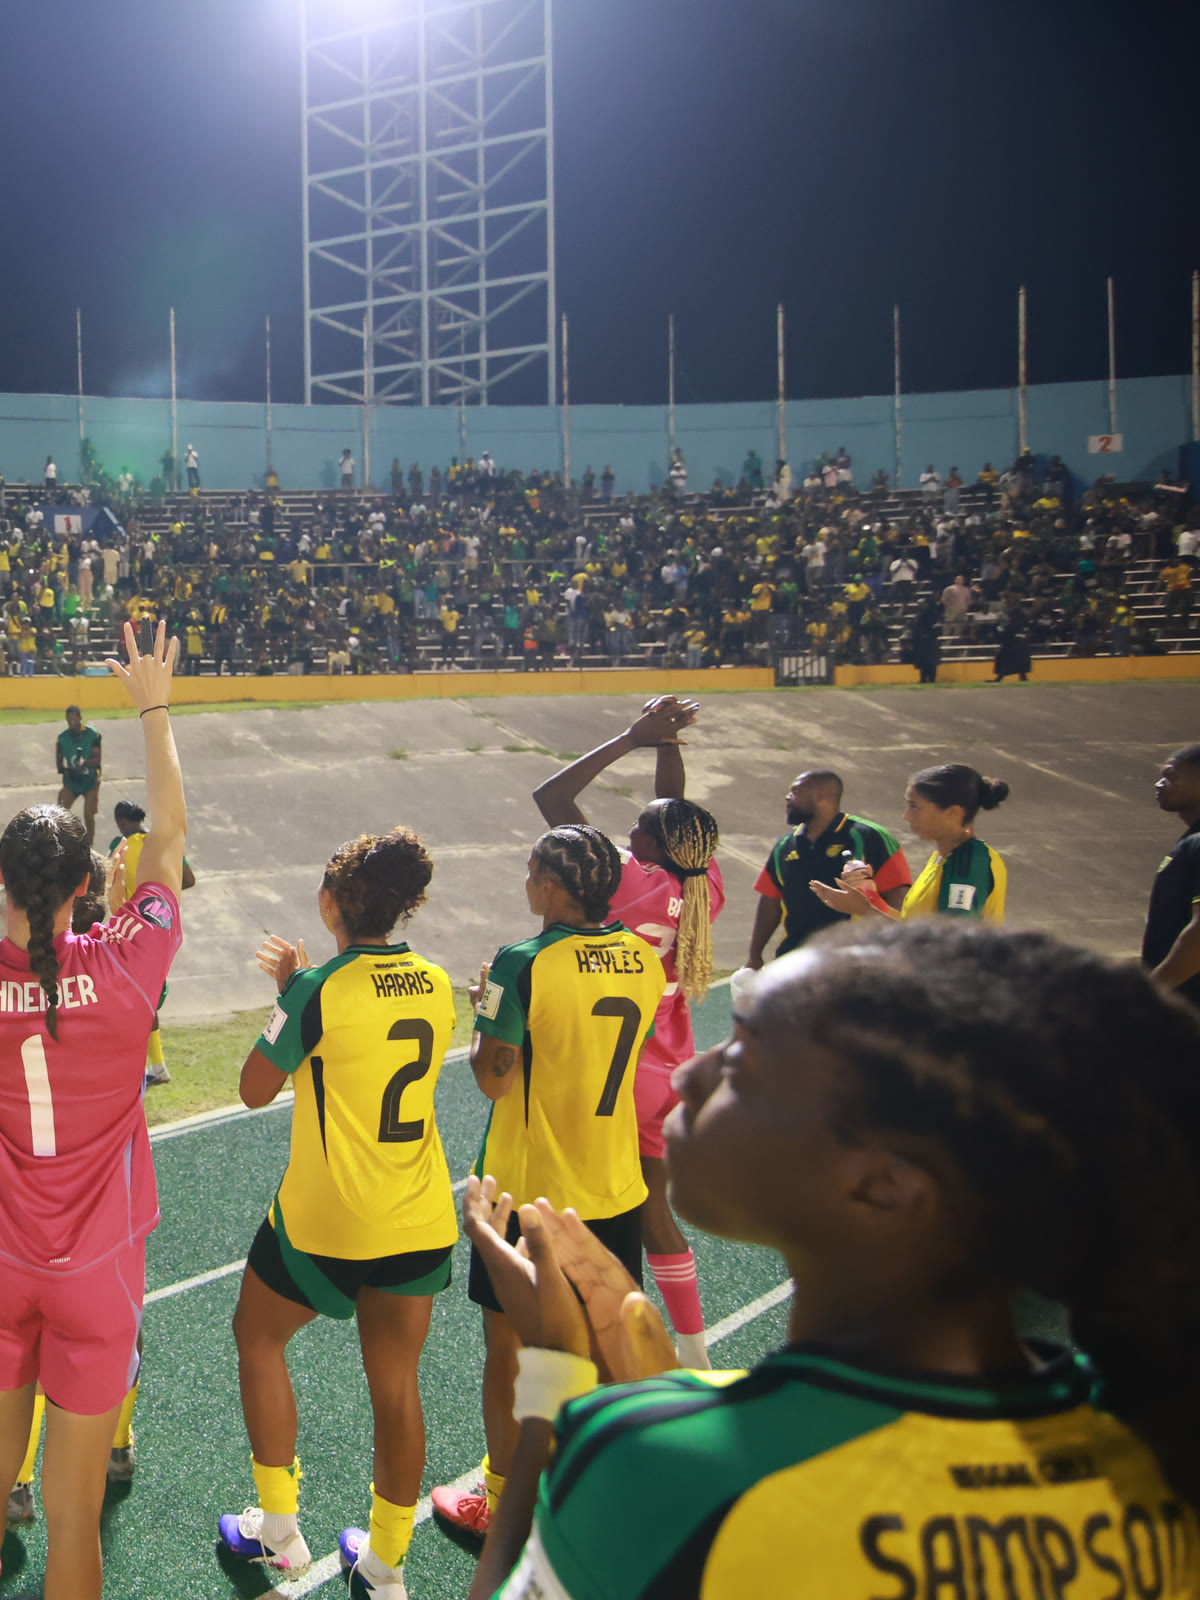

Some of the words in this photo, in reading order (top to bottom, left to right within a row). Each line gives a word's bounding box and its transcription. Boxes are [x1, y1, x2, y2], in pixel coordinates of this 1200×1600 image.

[1098, 436, 1113, 453] 2
[64, 516, 72, 533] 1
[575, 950, 644, 974] HAYLES
[370, 970, 434, 998] HARRIS
[591, 996, 642, 1117] 7
[378, 1018, 434, 1143] 2
[20, 1034, 57, 1157] 1
